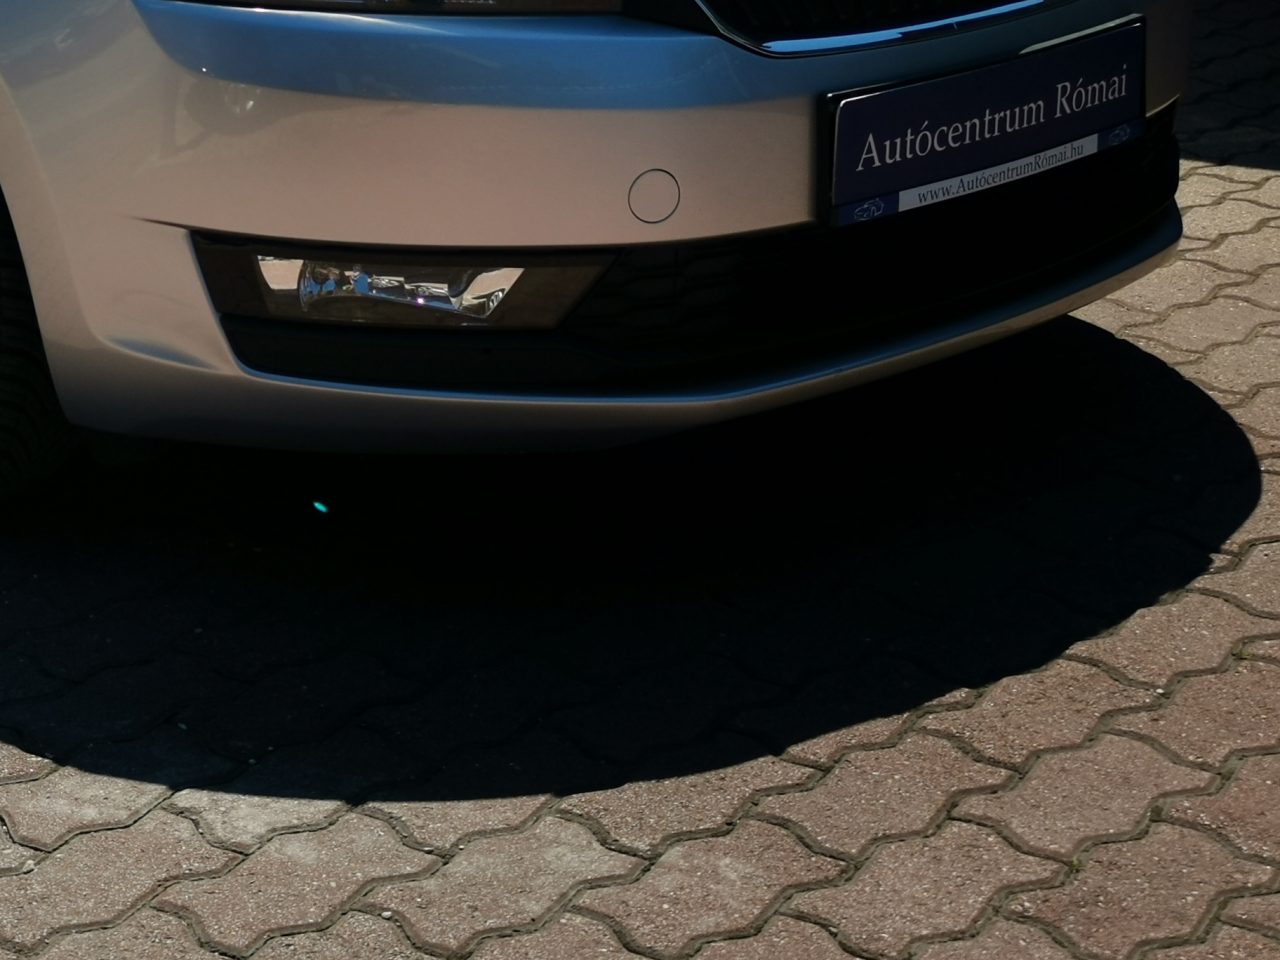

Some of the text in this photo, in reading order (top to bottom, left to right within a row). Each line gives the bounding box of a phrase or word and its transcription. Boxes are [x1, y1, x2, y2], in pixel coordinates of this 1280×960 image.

[856, 64, 1127, 172] Autócentrum Római
[918, 143, 1084, 204] www.AutócentrumRómai.hu
